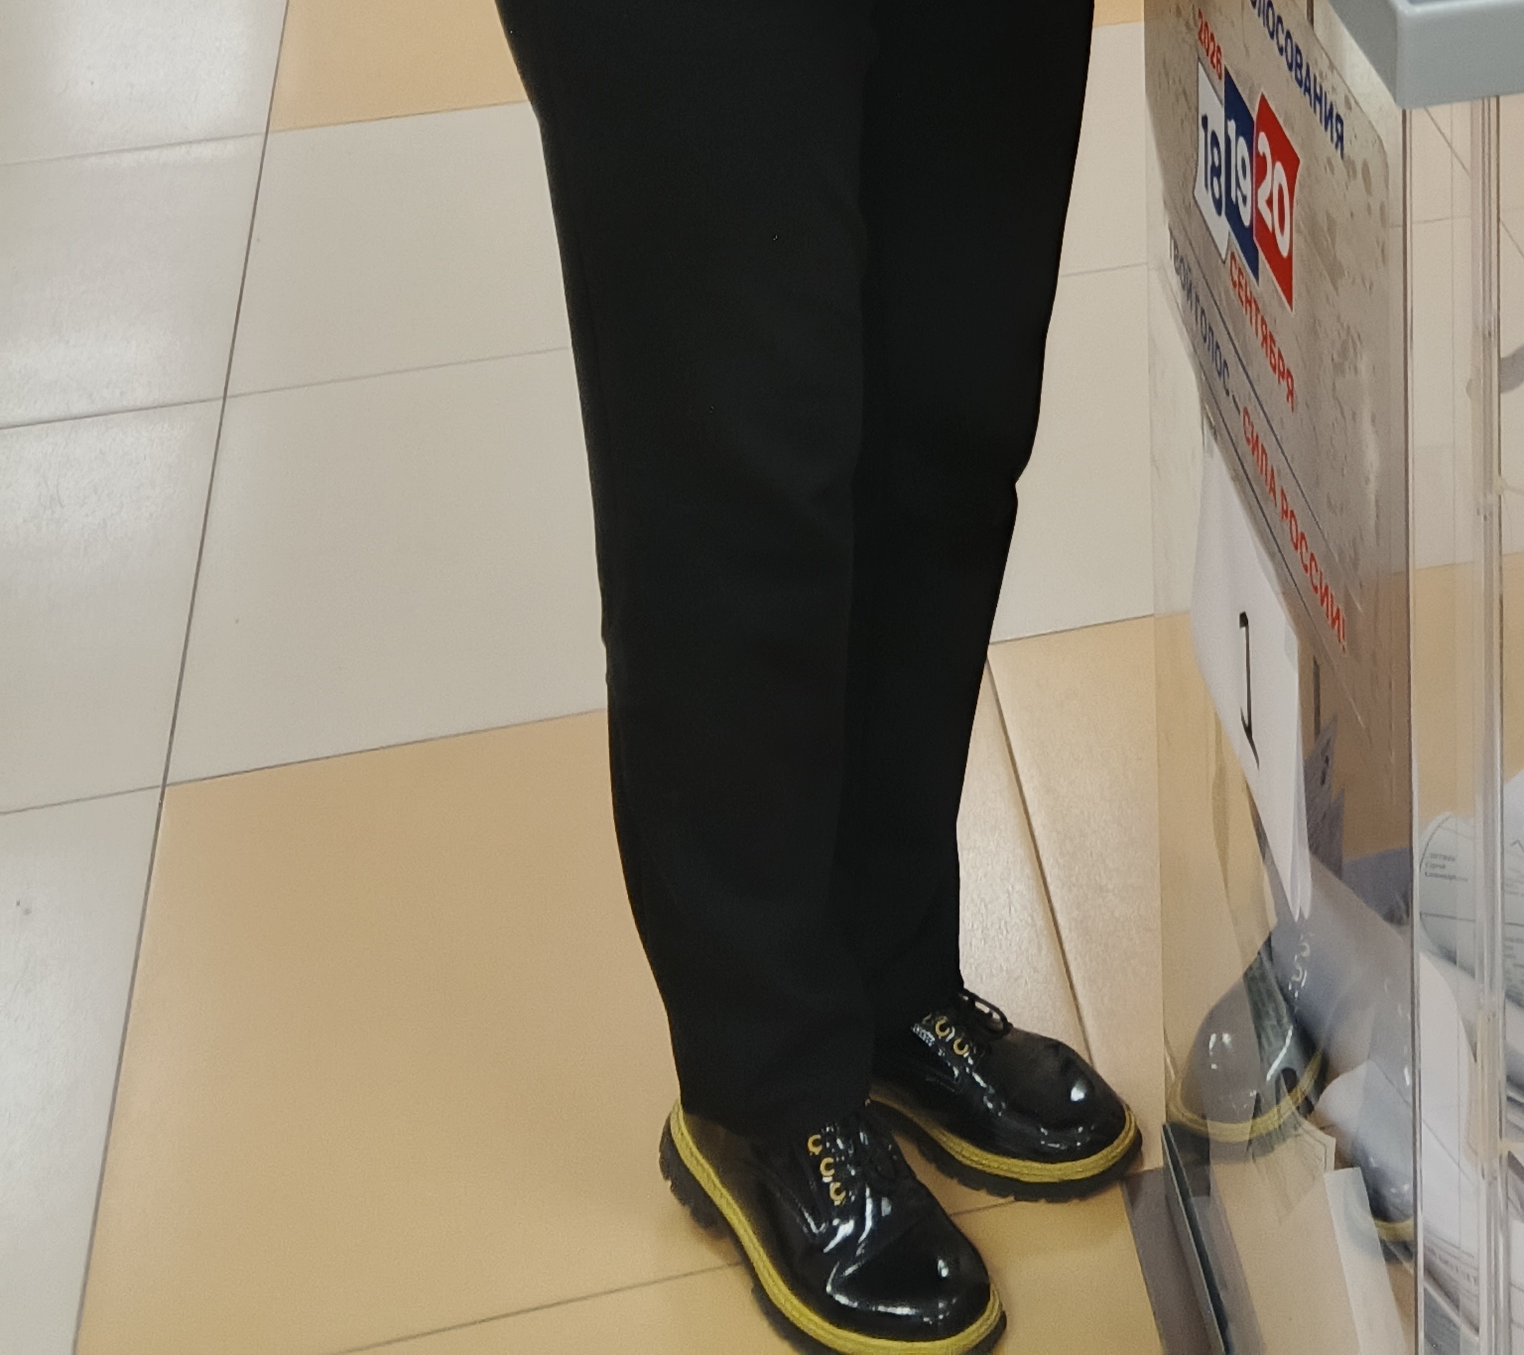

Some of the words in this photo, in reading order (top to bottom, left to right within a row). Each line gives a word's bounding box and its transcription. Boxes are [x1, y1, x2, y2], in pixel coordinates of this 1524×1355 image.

[1197, 7, 1223, 81] 2026
[1201, 114, 1223, 218] 18
[1227, 118, 1251, 228] 19
[1257, 131, 1291, 259] 20
[1229, 250, 1295, 413] СЕНТЯБРЯ
[1195, 293, 1230, 397] ГОЛОС
[1243, 406, 1277, 508] СИЛА
[1280, 484, 1346, 655] РОССИИ!
